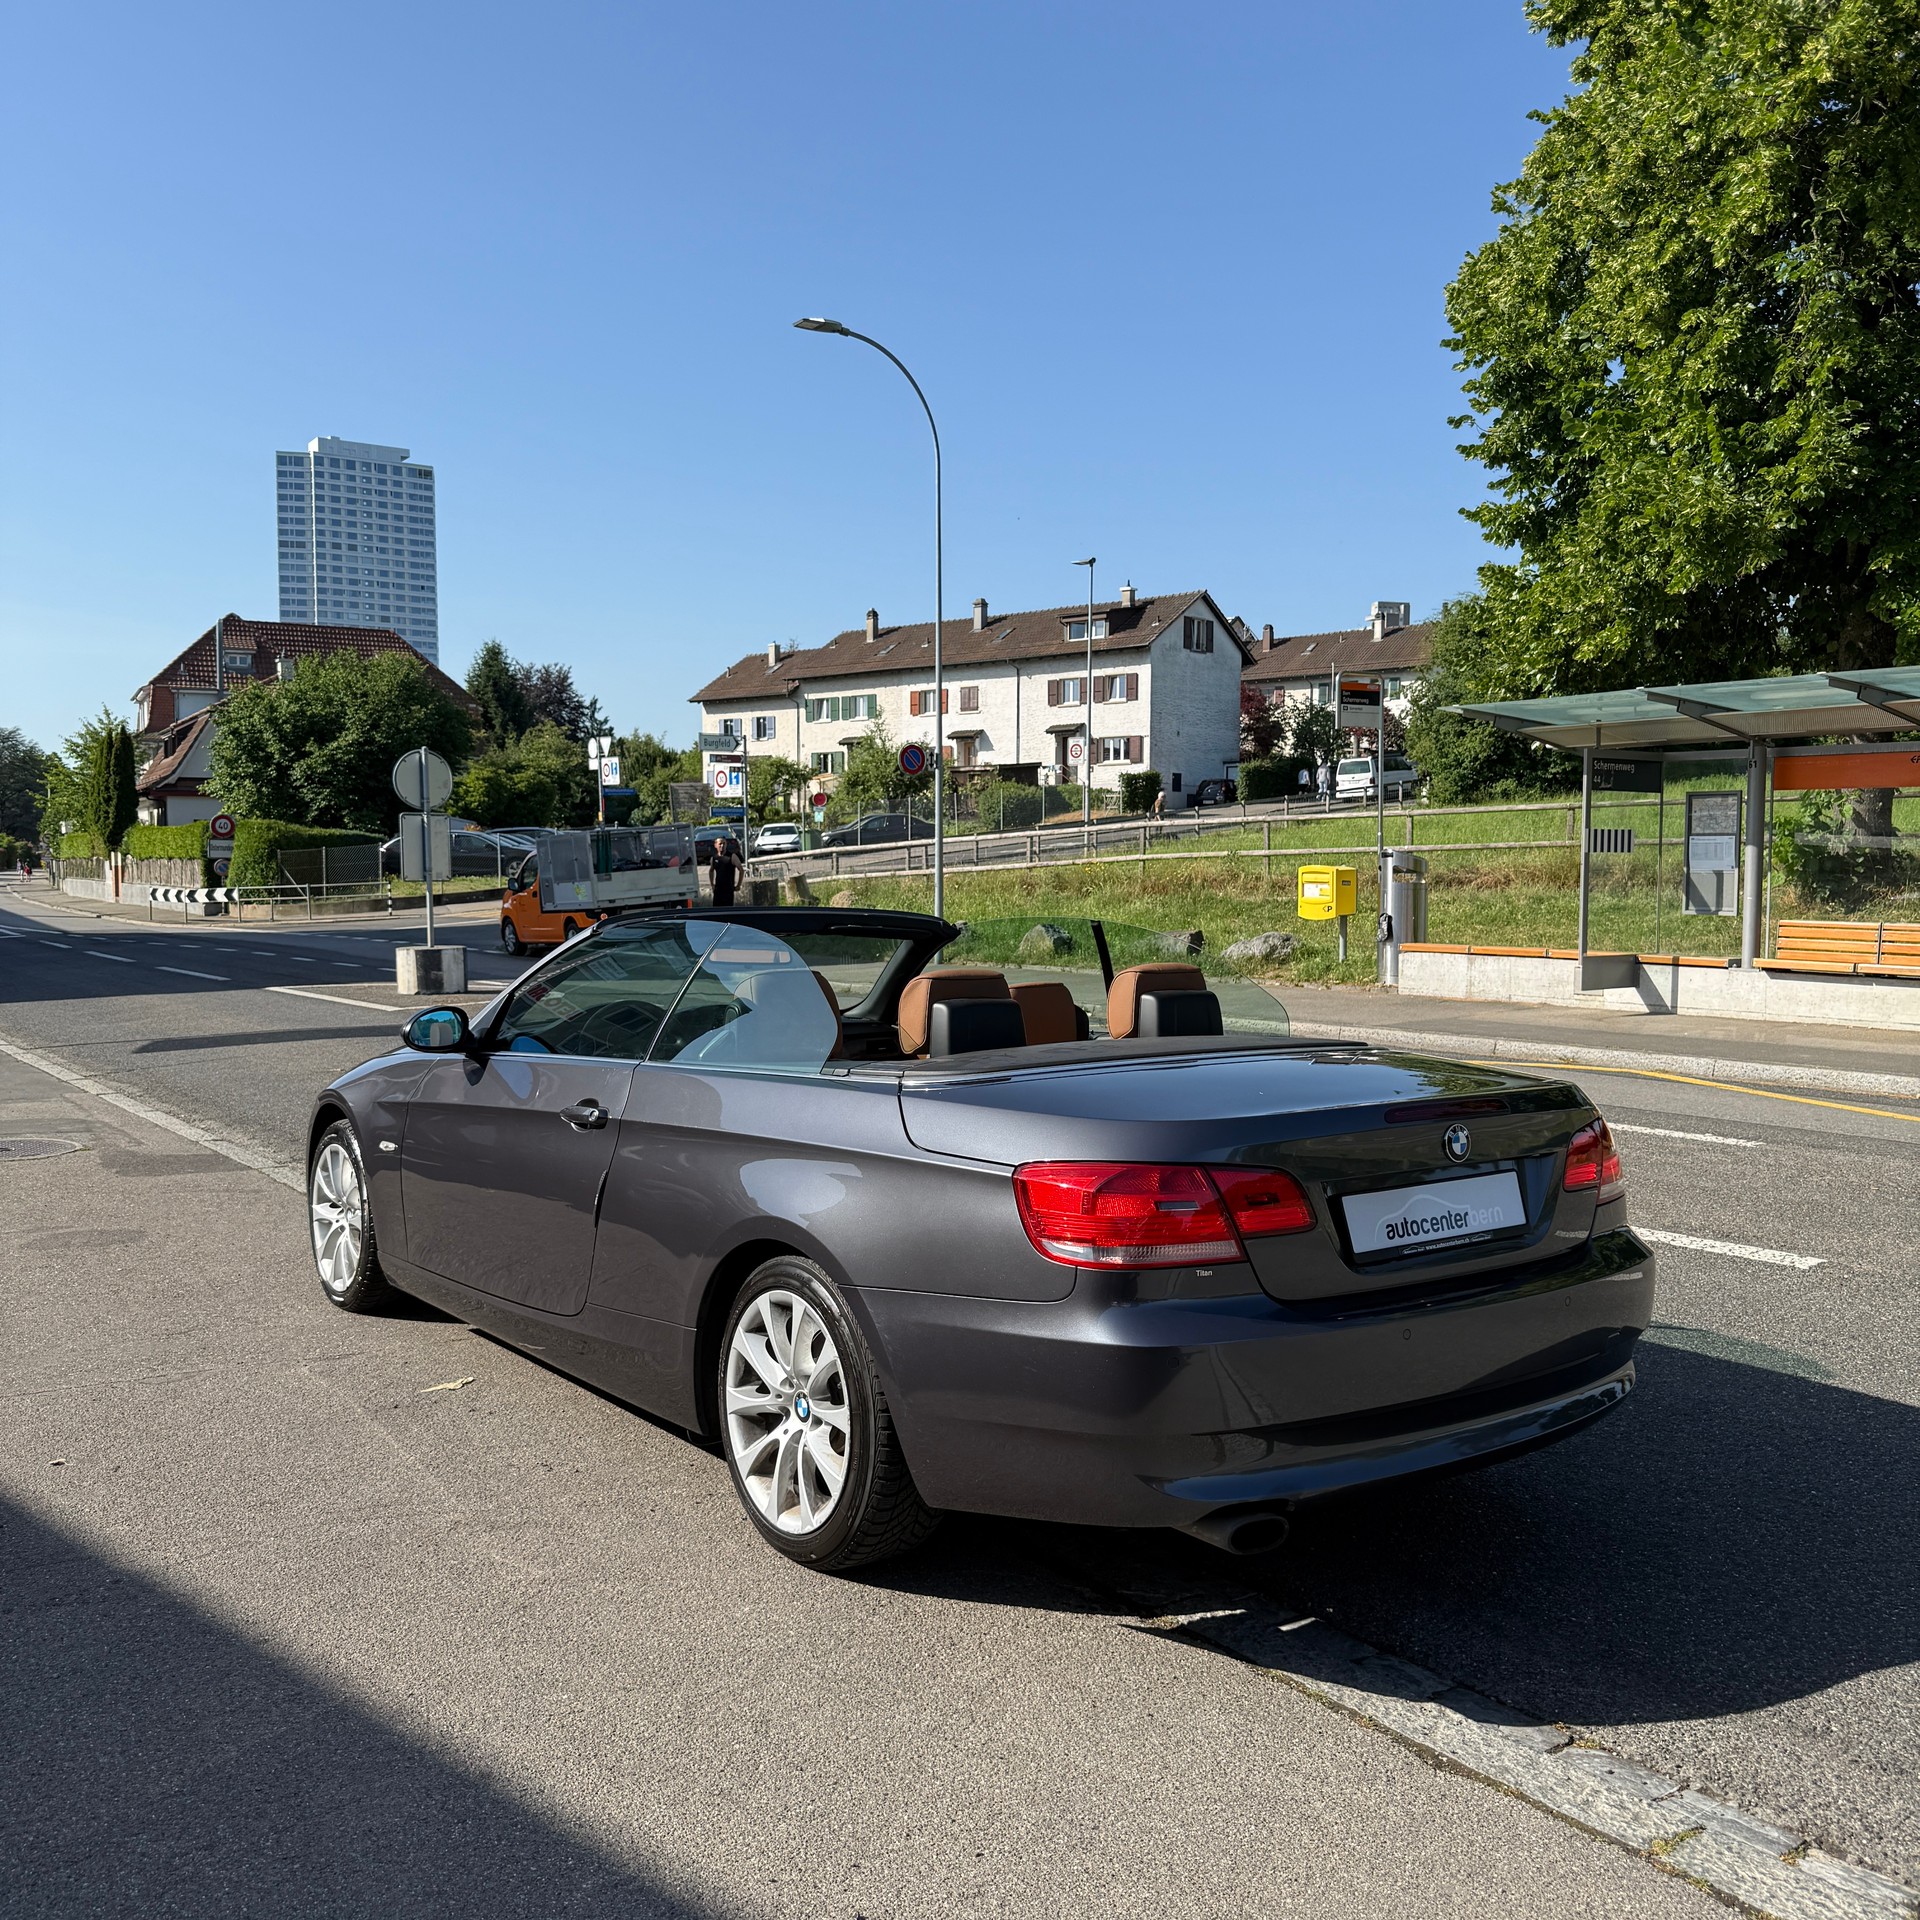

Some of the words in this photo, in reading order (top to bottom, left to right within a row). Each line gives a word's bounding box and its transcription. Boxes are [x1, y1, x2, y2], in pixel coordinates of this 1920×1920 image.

[704, 739, 731, 749] Burgfeld
[1593, 760, 1635, 774] Schermenweg
[218, 821, 229, 830] 40
[1195, 1269, 1213, 1277] Titan
